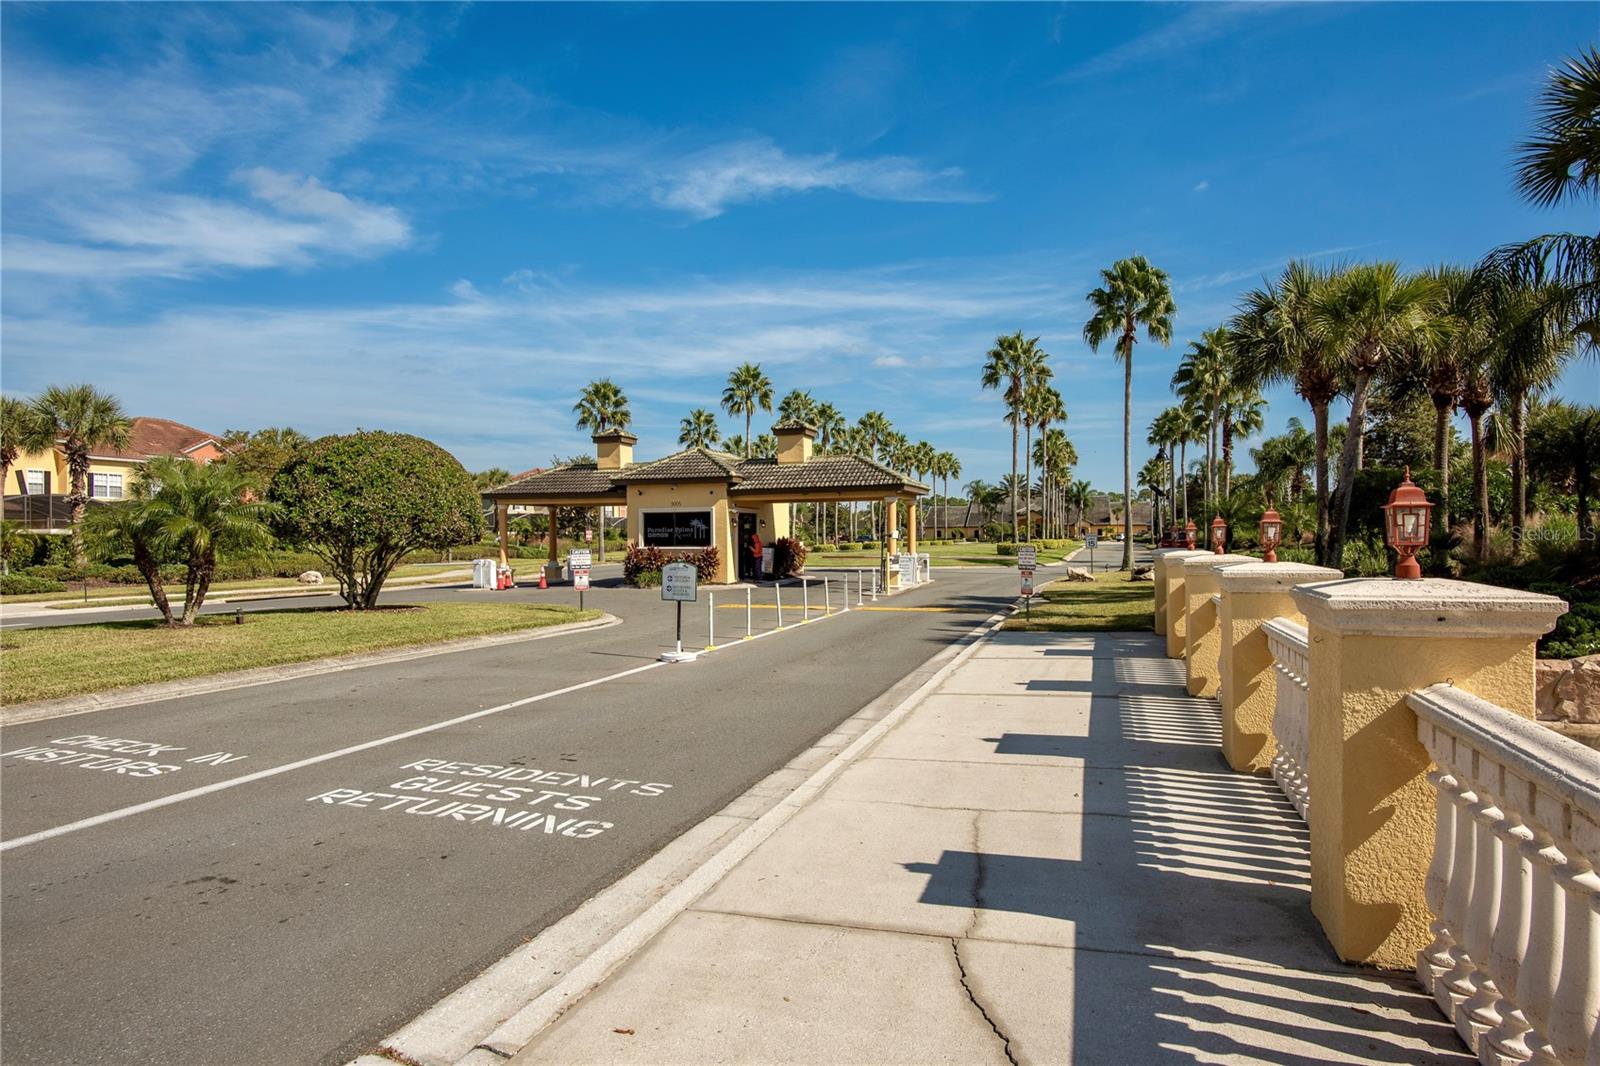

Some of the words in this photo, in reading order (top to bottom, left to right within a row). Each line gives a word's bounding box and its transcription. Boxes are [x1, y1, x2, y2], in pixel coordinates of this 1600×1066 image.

[0, 746, 182, 777] VISITORS
[50, 735, 187, 757] CHECK
[185, 751, 249, 766] IN
[389, 776, 602, 811] GUESTS
[399, 758, 673, 797] RESIDENTS
[305, 788, 615, 839] RETURNING
